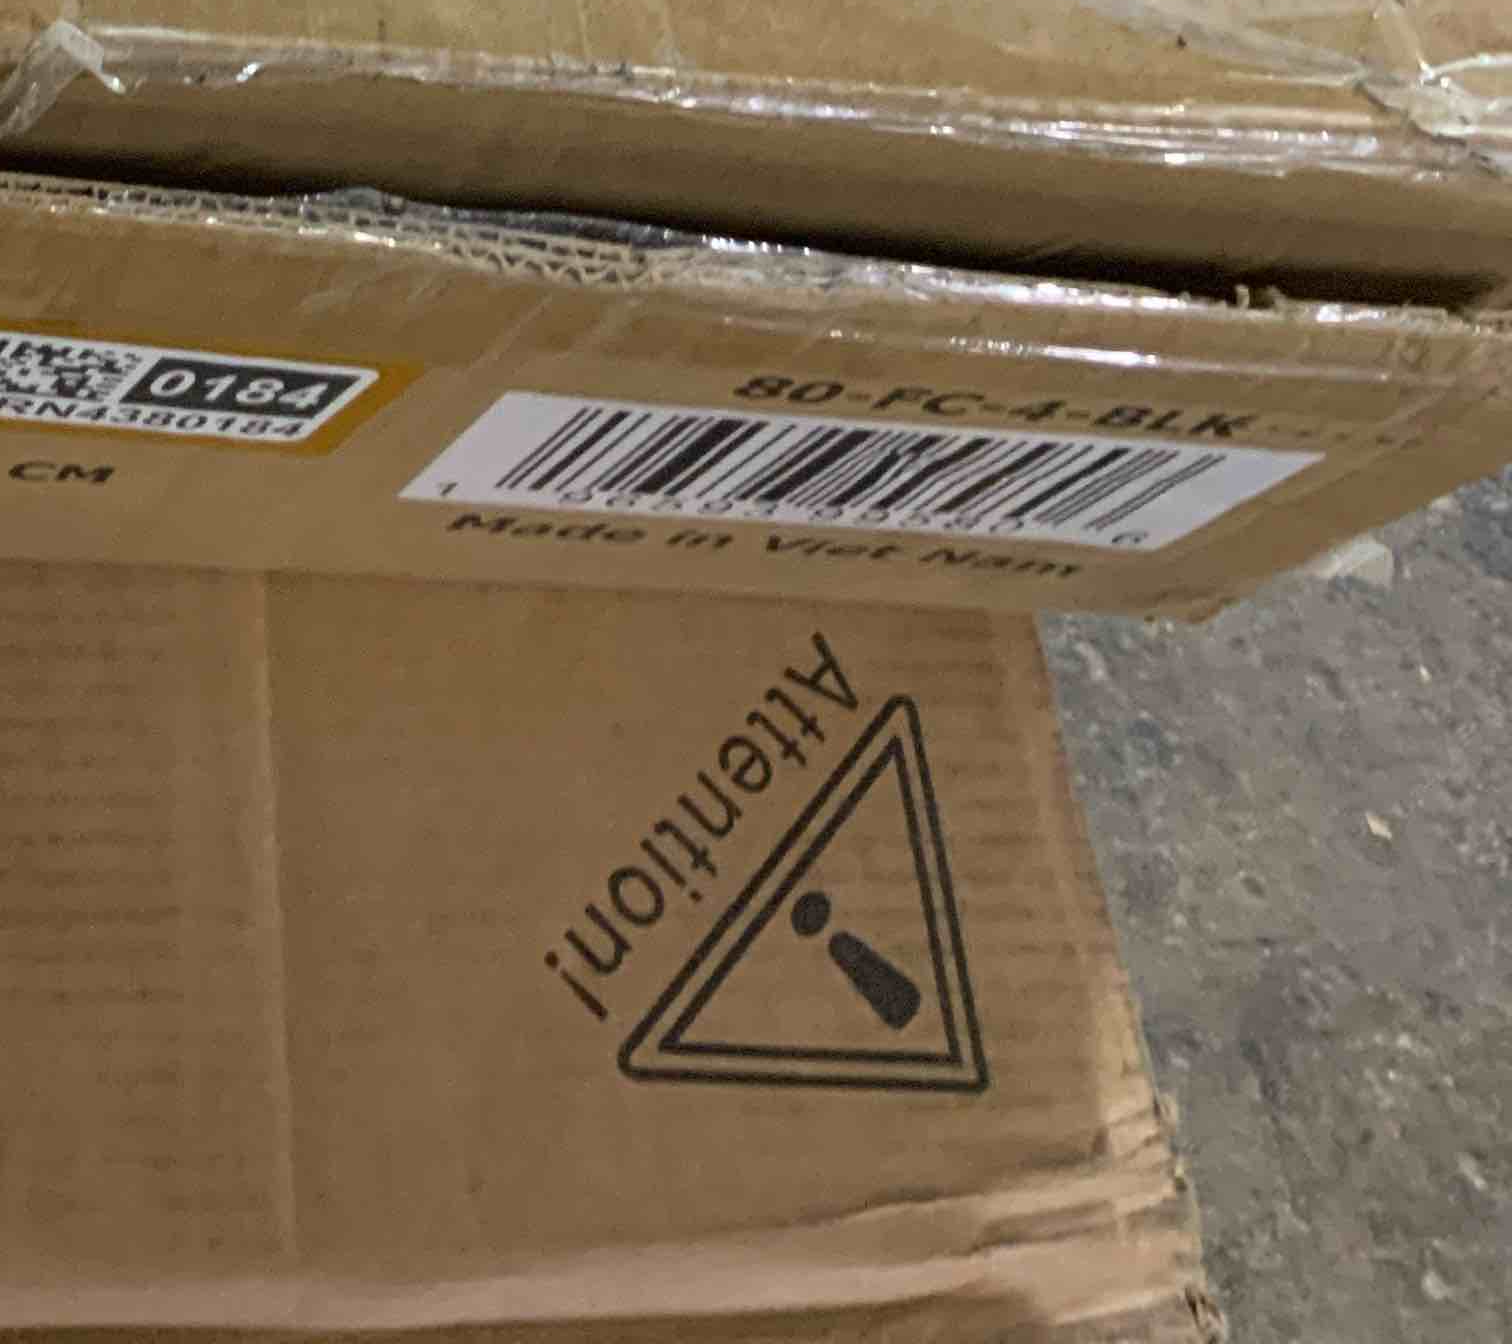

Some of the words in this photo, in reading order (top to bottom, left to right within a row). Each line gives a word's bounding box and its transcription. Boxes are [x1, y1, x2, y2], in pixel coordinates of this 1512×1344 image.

[144, 367, 329, 414] 0184
[733, 377, 1258, 439] 80-FC-4-BLK
[8, 461, 117, 488] CM
[446, 513, 645, 546] Made
[666, 530, 734, 550] in
[766, 534, 897, 560] Viet
[919, 547, 1084, 579] Nam
[544, 631, 859, 1021] Attention!
